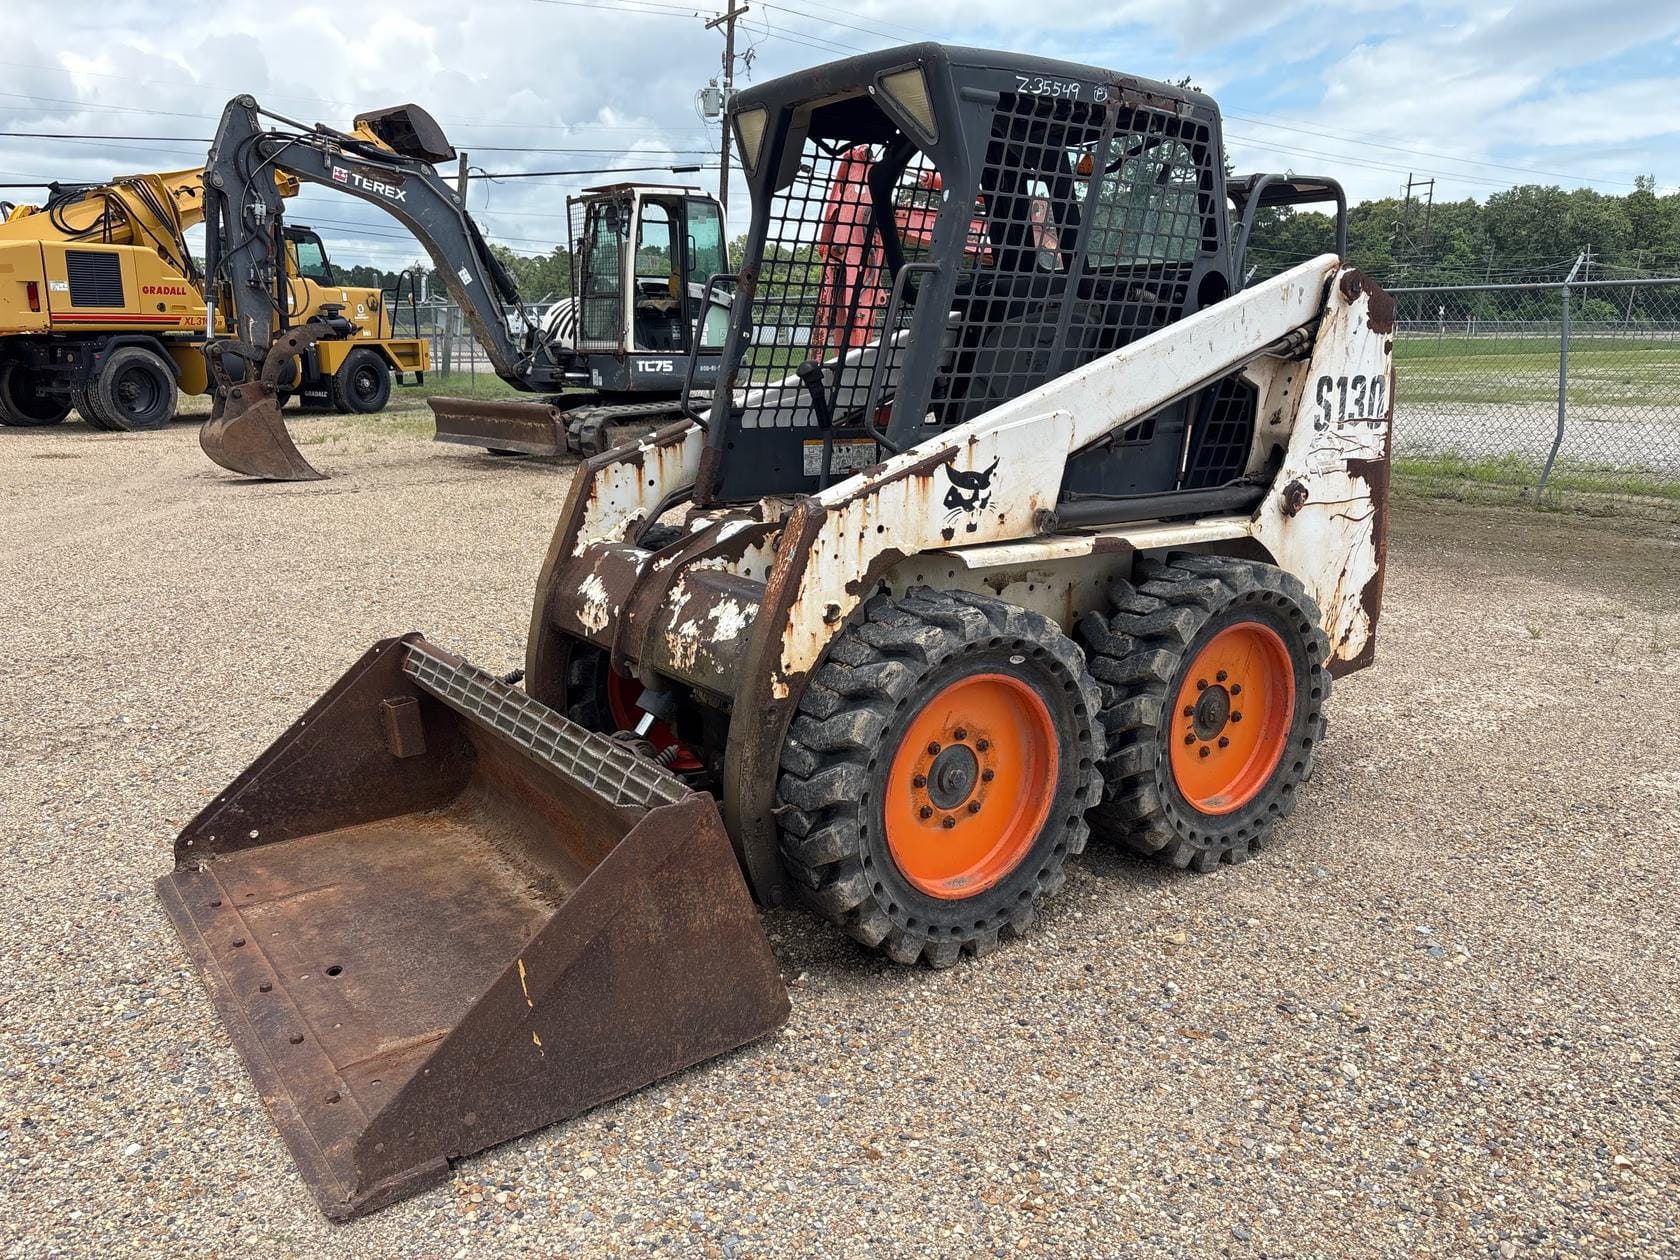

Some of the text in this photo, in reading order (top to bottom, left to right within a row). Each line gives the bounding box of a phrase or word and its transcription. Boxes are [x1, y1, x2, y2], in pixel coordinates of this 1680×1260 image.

[351, 173, 407, 203] TEREX
[142, 286, 187, 296] GRADALL
[184, 316, 218, 326] XL31
[636, 360, 673, 372] TC75
[1313, 374, 1386, 432] S130
